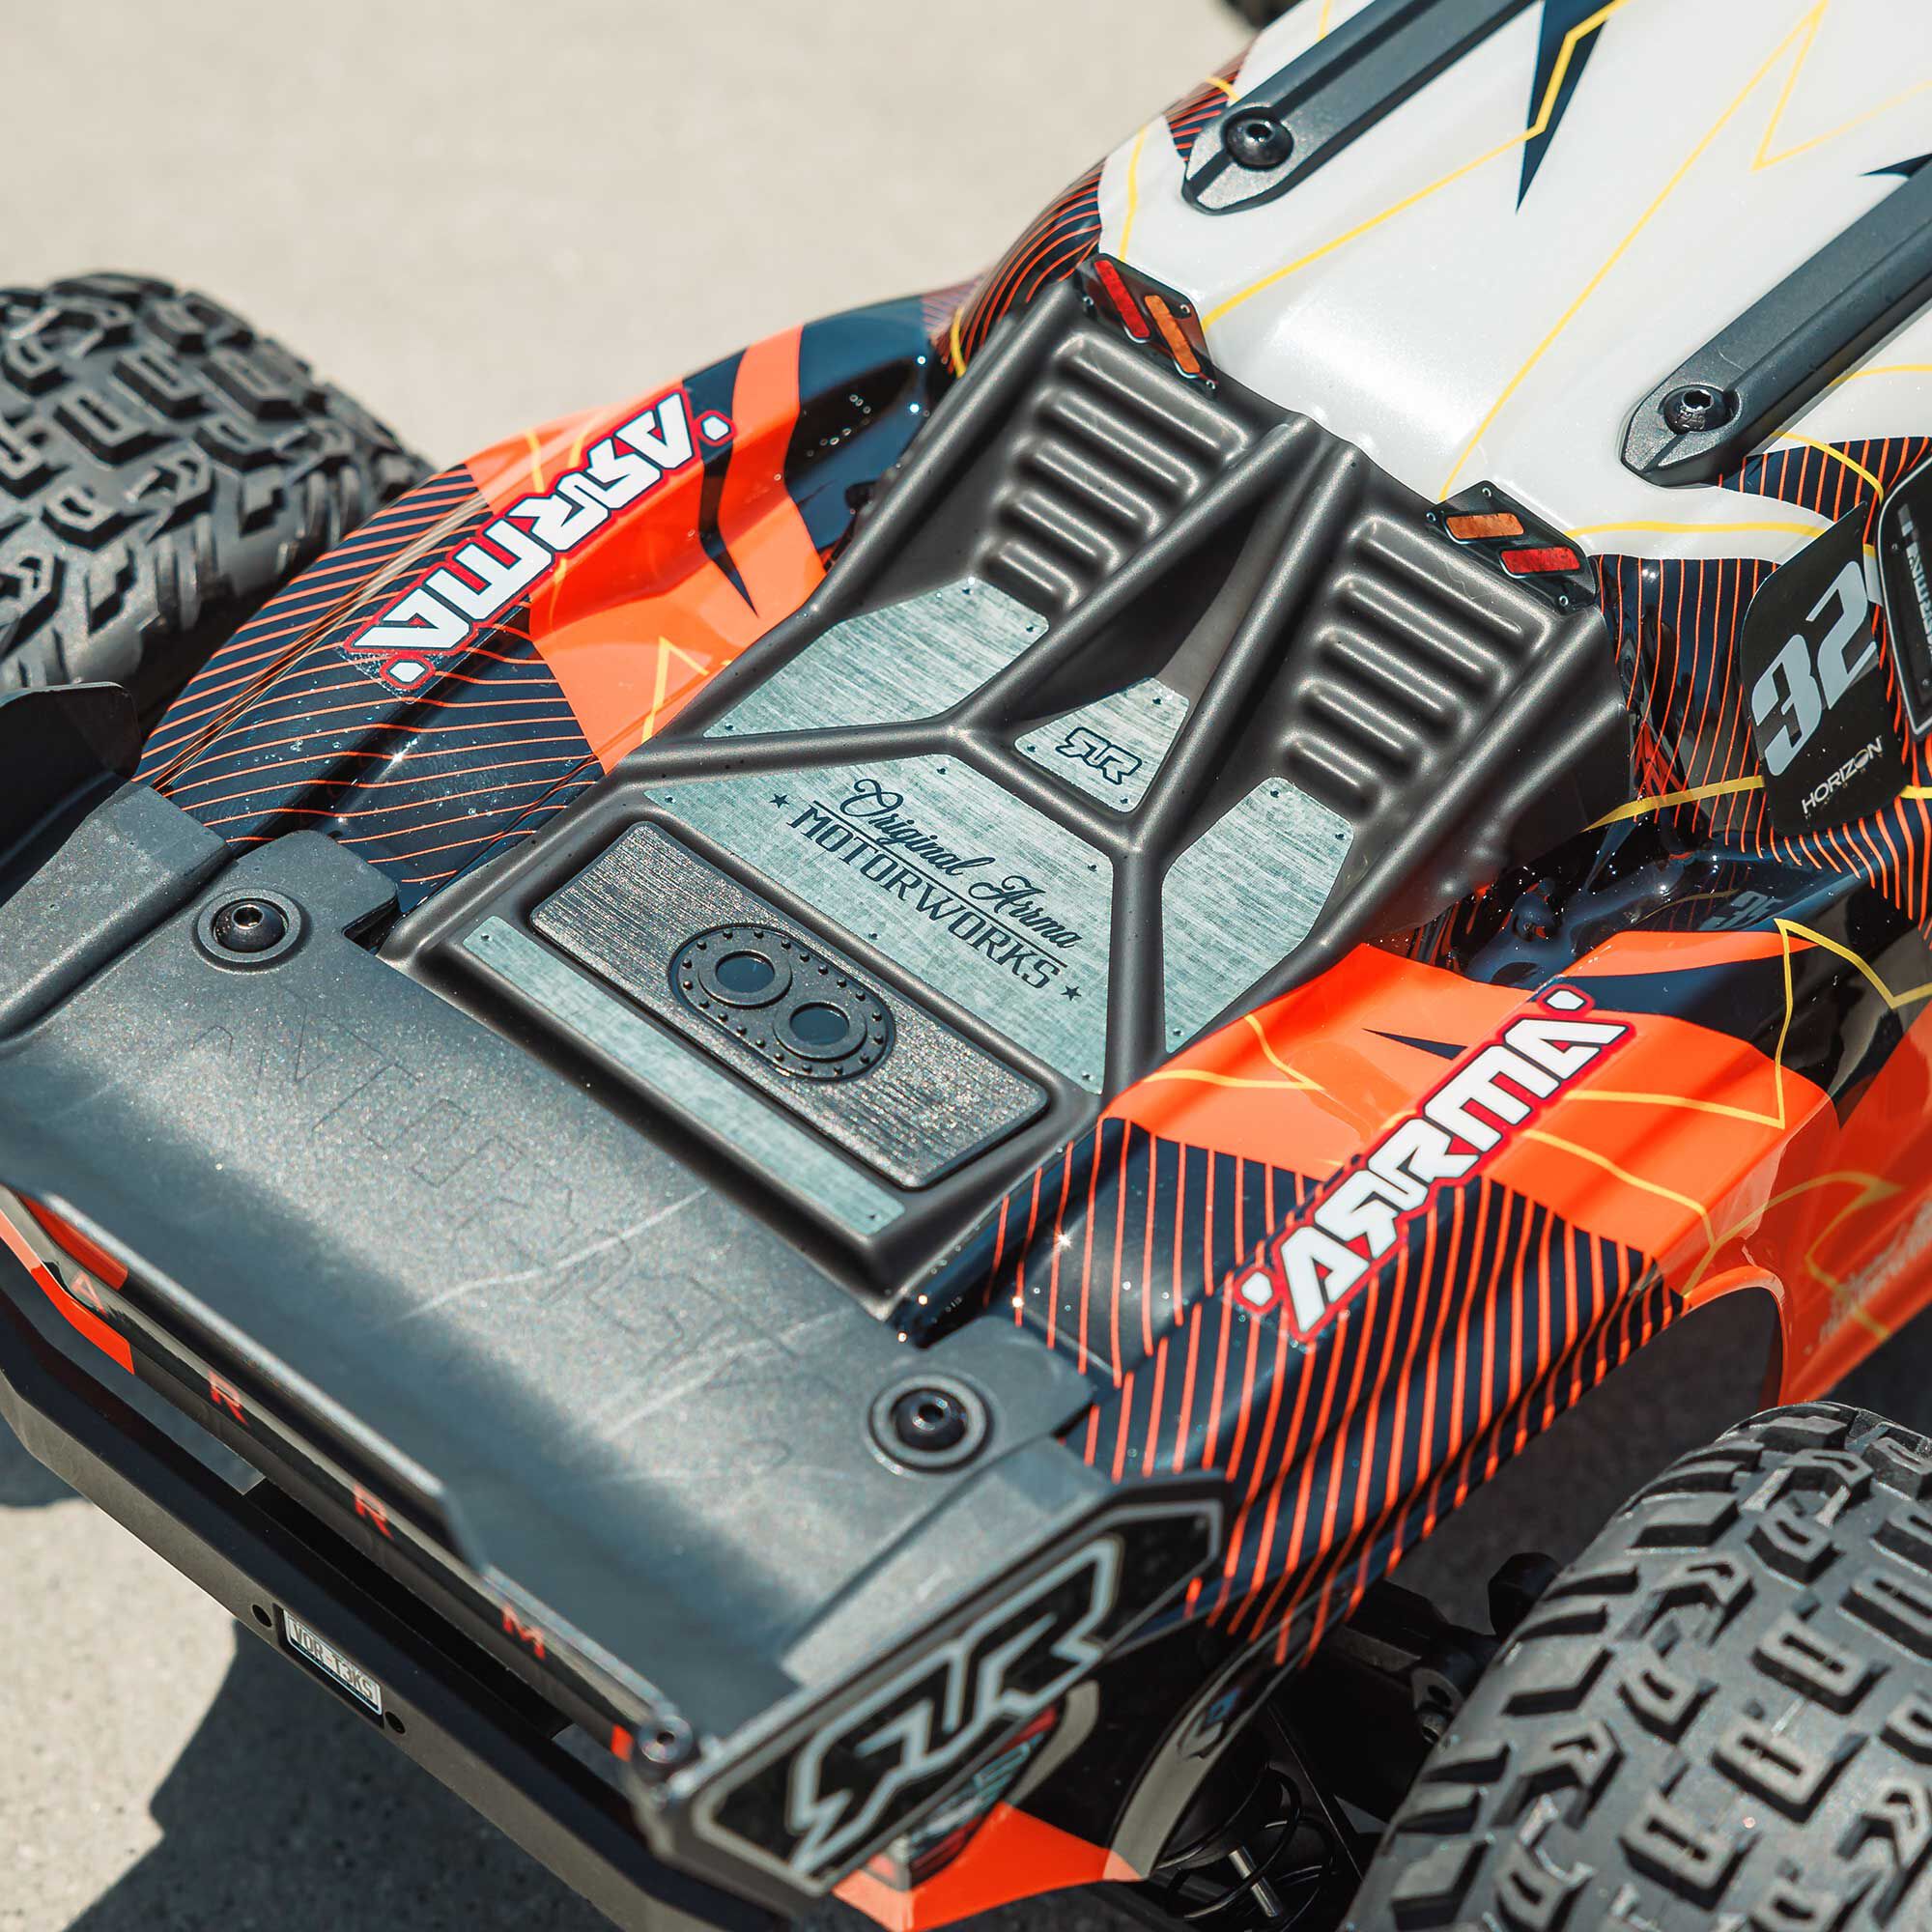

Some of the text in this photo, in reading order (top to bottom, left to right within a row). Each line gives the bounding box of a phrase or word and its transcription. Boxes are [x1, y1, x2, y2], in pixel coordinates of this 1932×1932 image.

[1751, 561, 1877, 777] 32
[1802, 736, 1883, 813] HORIZON
[786, 807, 1060, 989] MOTORWORKS
[839, 779, 1083, 948] Original Arrma
